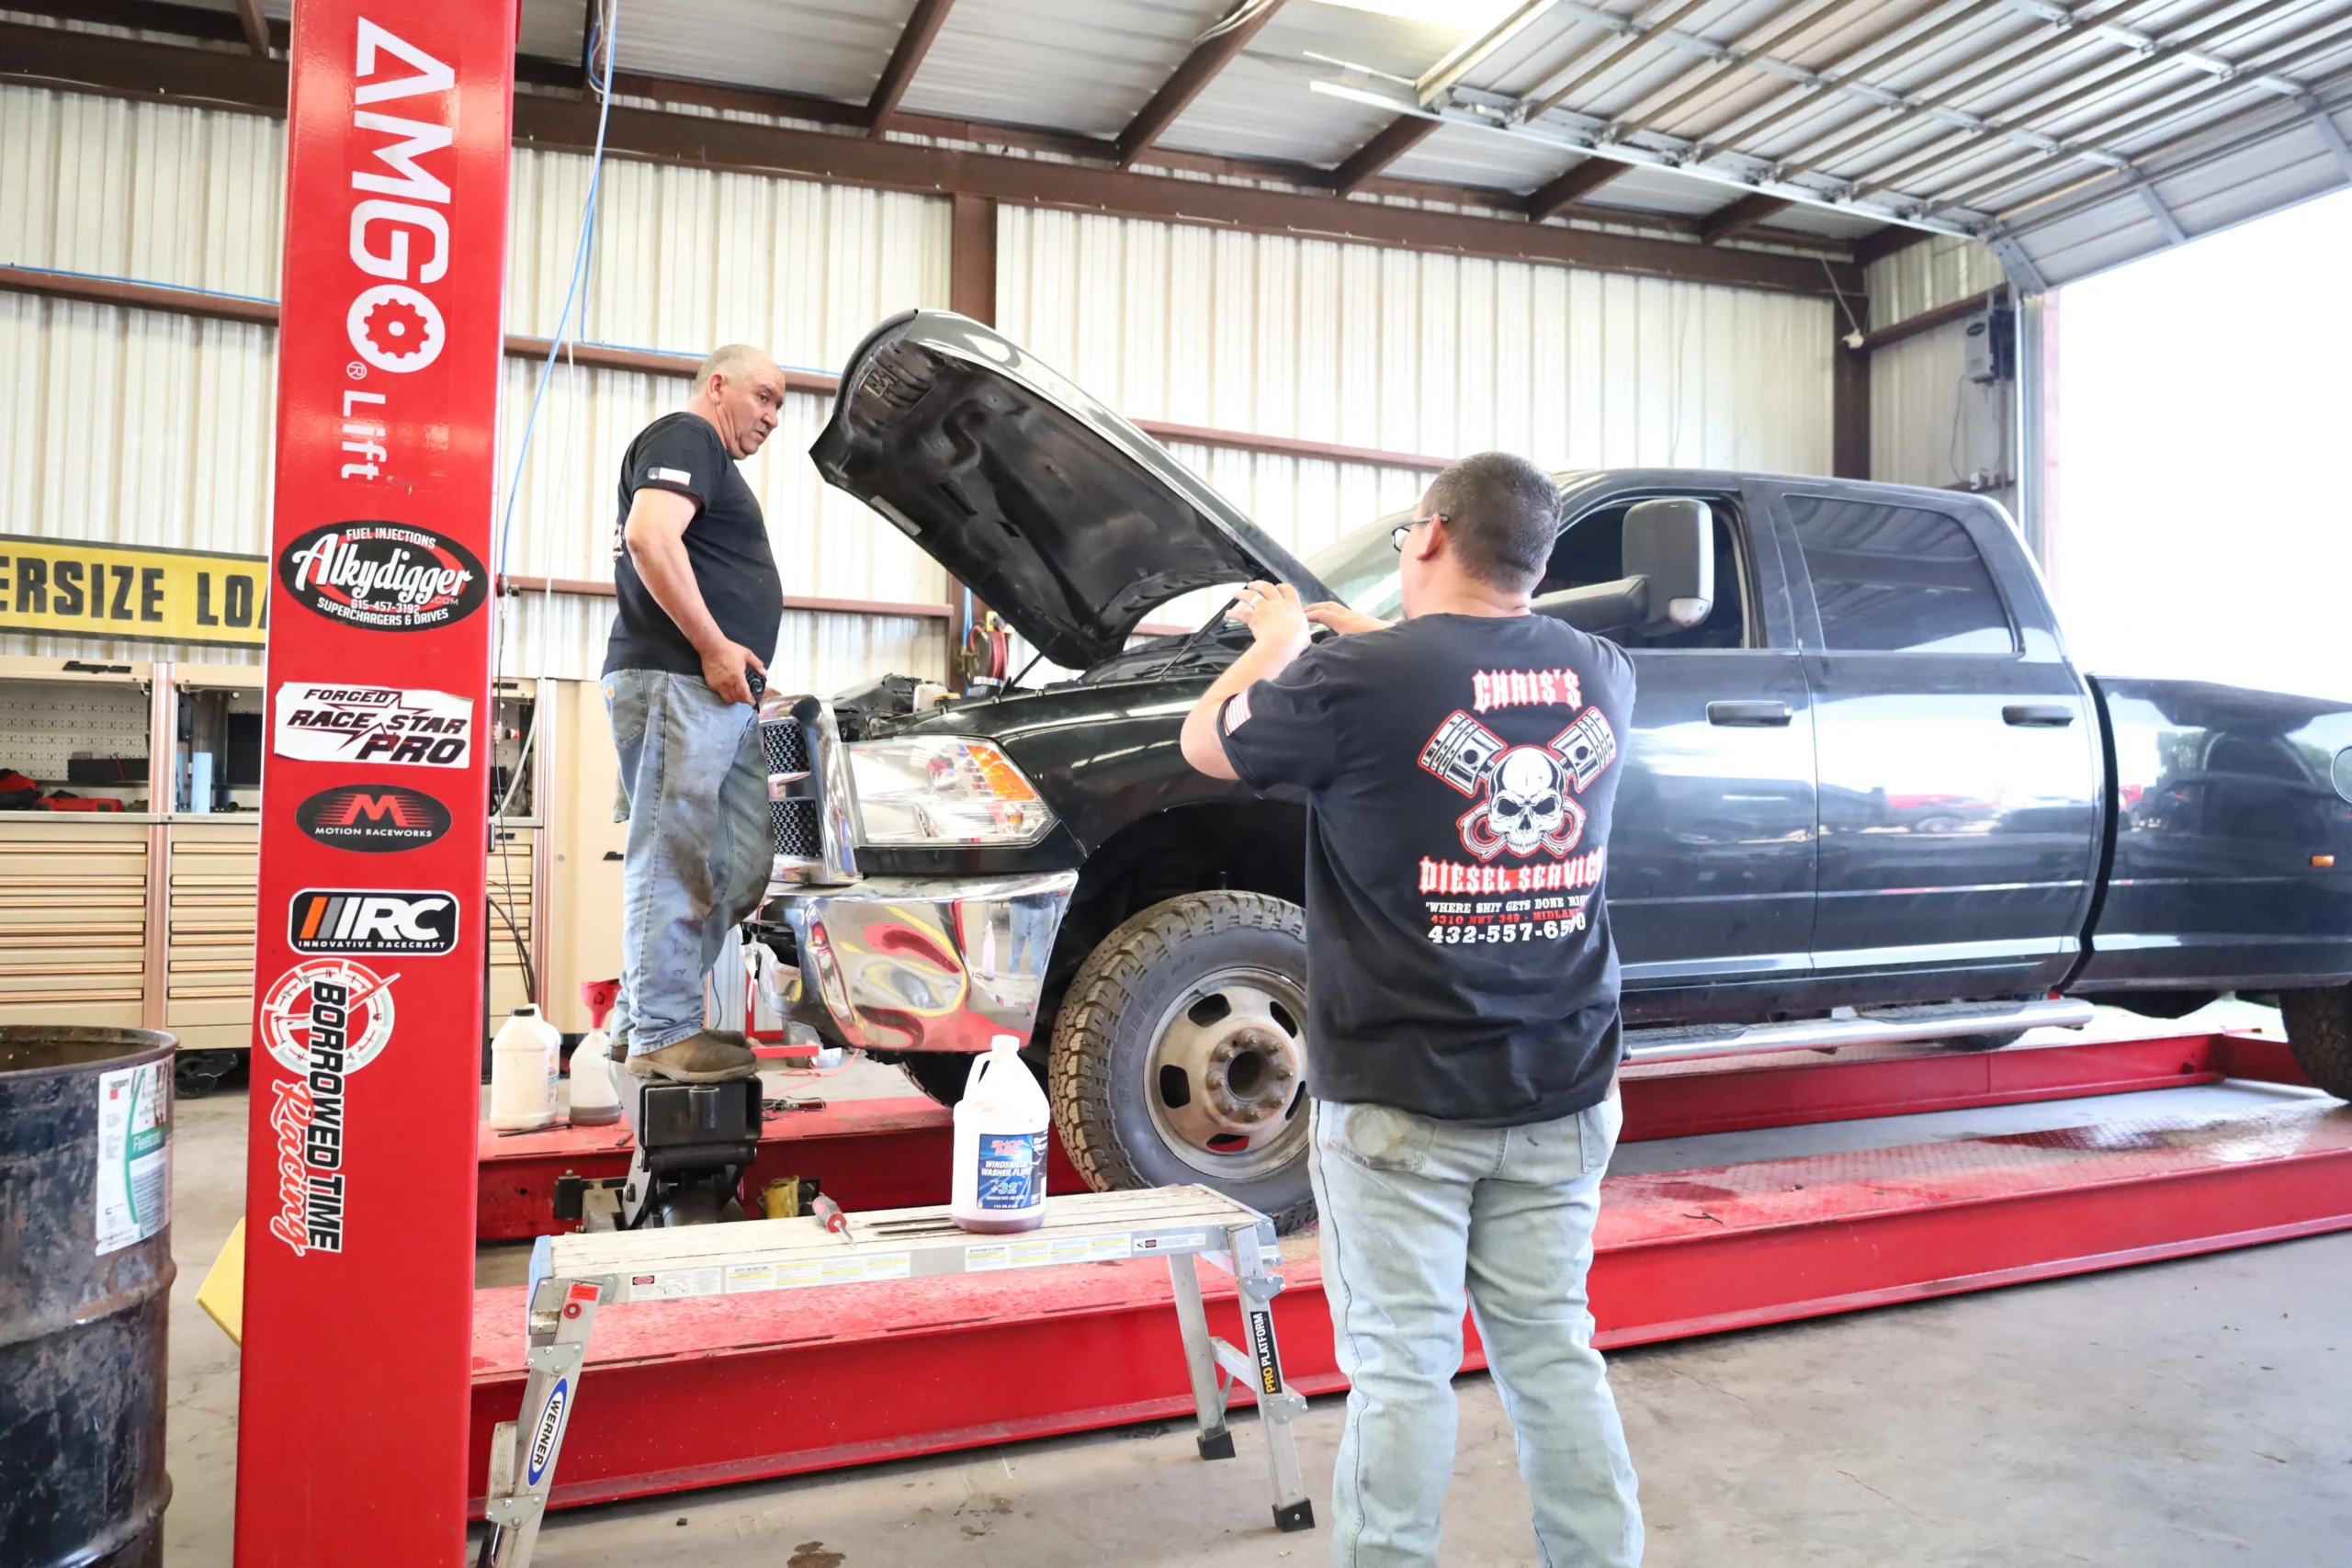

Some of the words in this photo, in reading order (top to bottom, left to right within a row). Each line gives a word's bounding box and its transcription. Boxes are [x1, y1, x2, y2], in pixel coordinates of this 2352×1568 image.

[341, 389, 387, 480] Lift
[345, 527, 372, 541] FUEL
[375, 527, 436, 549] INJECTIONS
[291, 534, 473, 604] Alkydigger
[317, 597, 402, 626] SUPERCHARGERS
[404, 615, 412, 626] &
[413, 608, 448, 625] DRIVES
[350, 599, 421, 614] 615-457-3192
[303, 689, 390, 703] FORGED
[1473, 669, 1582, 714] CHRIS'S
[287, 710, 379, 728] RACE
[385, 715, 468, 735] STAR
[355, 733, 467, 764] PRO
[315, 827, 362, 835] MOTION
[366, 829, 433, 837] RACEWORKS
[1419, 855, 1510, 896] DIESEL
[1476, 901, 1502, 913] SHIT
[1506, 899, 1531, 911] GETS
[1534, 897, 1565, 909] DONE
[1430, 915, 1464, 925] 4310
[1469, 915, 1494, 925] HWY
[305, 980, 347, 1168] BORROWED
[271, 1079, 315, 1256] Racing
[981, 1168, 1012, 1176] WASHER
[986, 1160, 1028, 1168] WINDSHIELD
[309, 1175, 345, 1252] TIME
[1253, 1313, 1272, 1367] PLATFORM
[1262, 1366, 1276, 1393] PRO
[533, 1400, 562, 1466] WERNER
